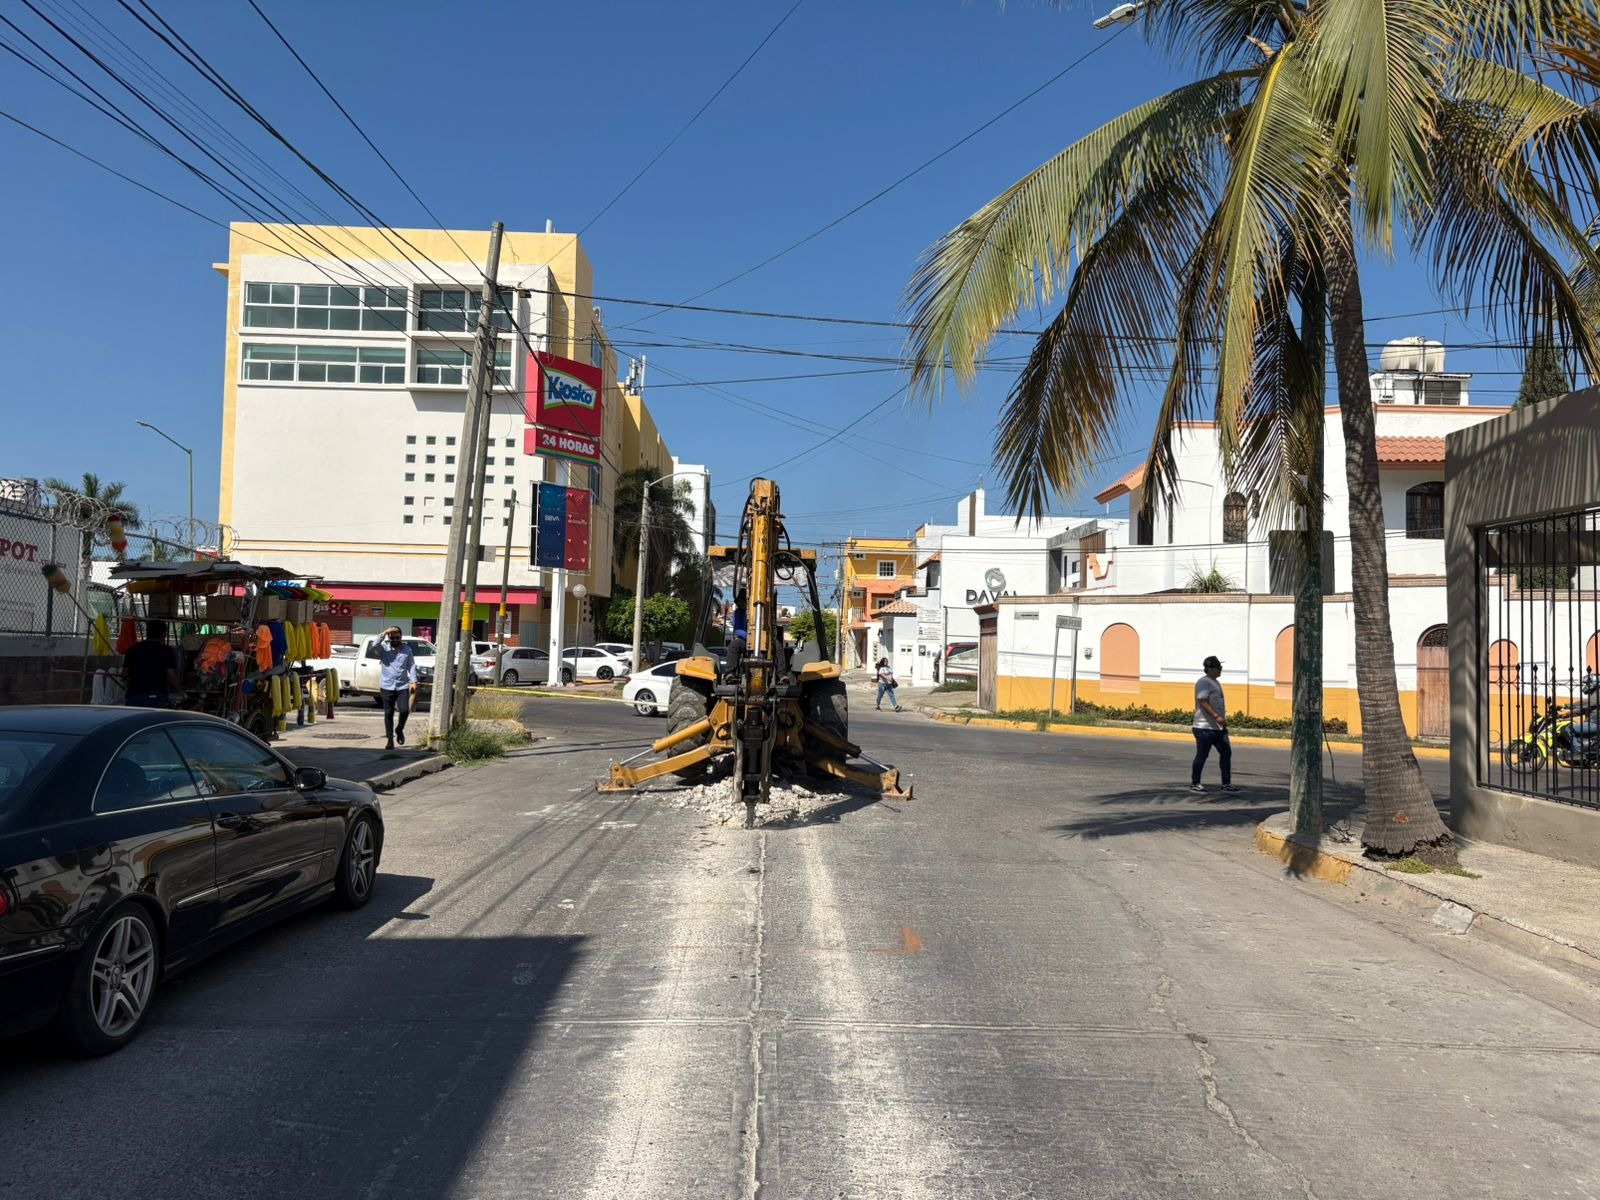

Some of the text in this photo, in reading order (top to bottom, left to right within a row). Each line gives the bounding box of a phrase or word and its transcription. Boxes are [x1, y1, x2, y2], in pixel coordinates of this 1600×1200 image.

[548, 376, 593, 404] Kiosko
[542, 433, 595, 455] 24 HORAS
[544, 514, 560, 522] BBVA
